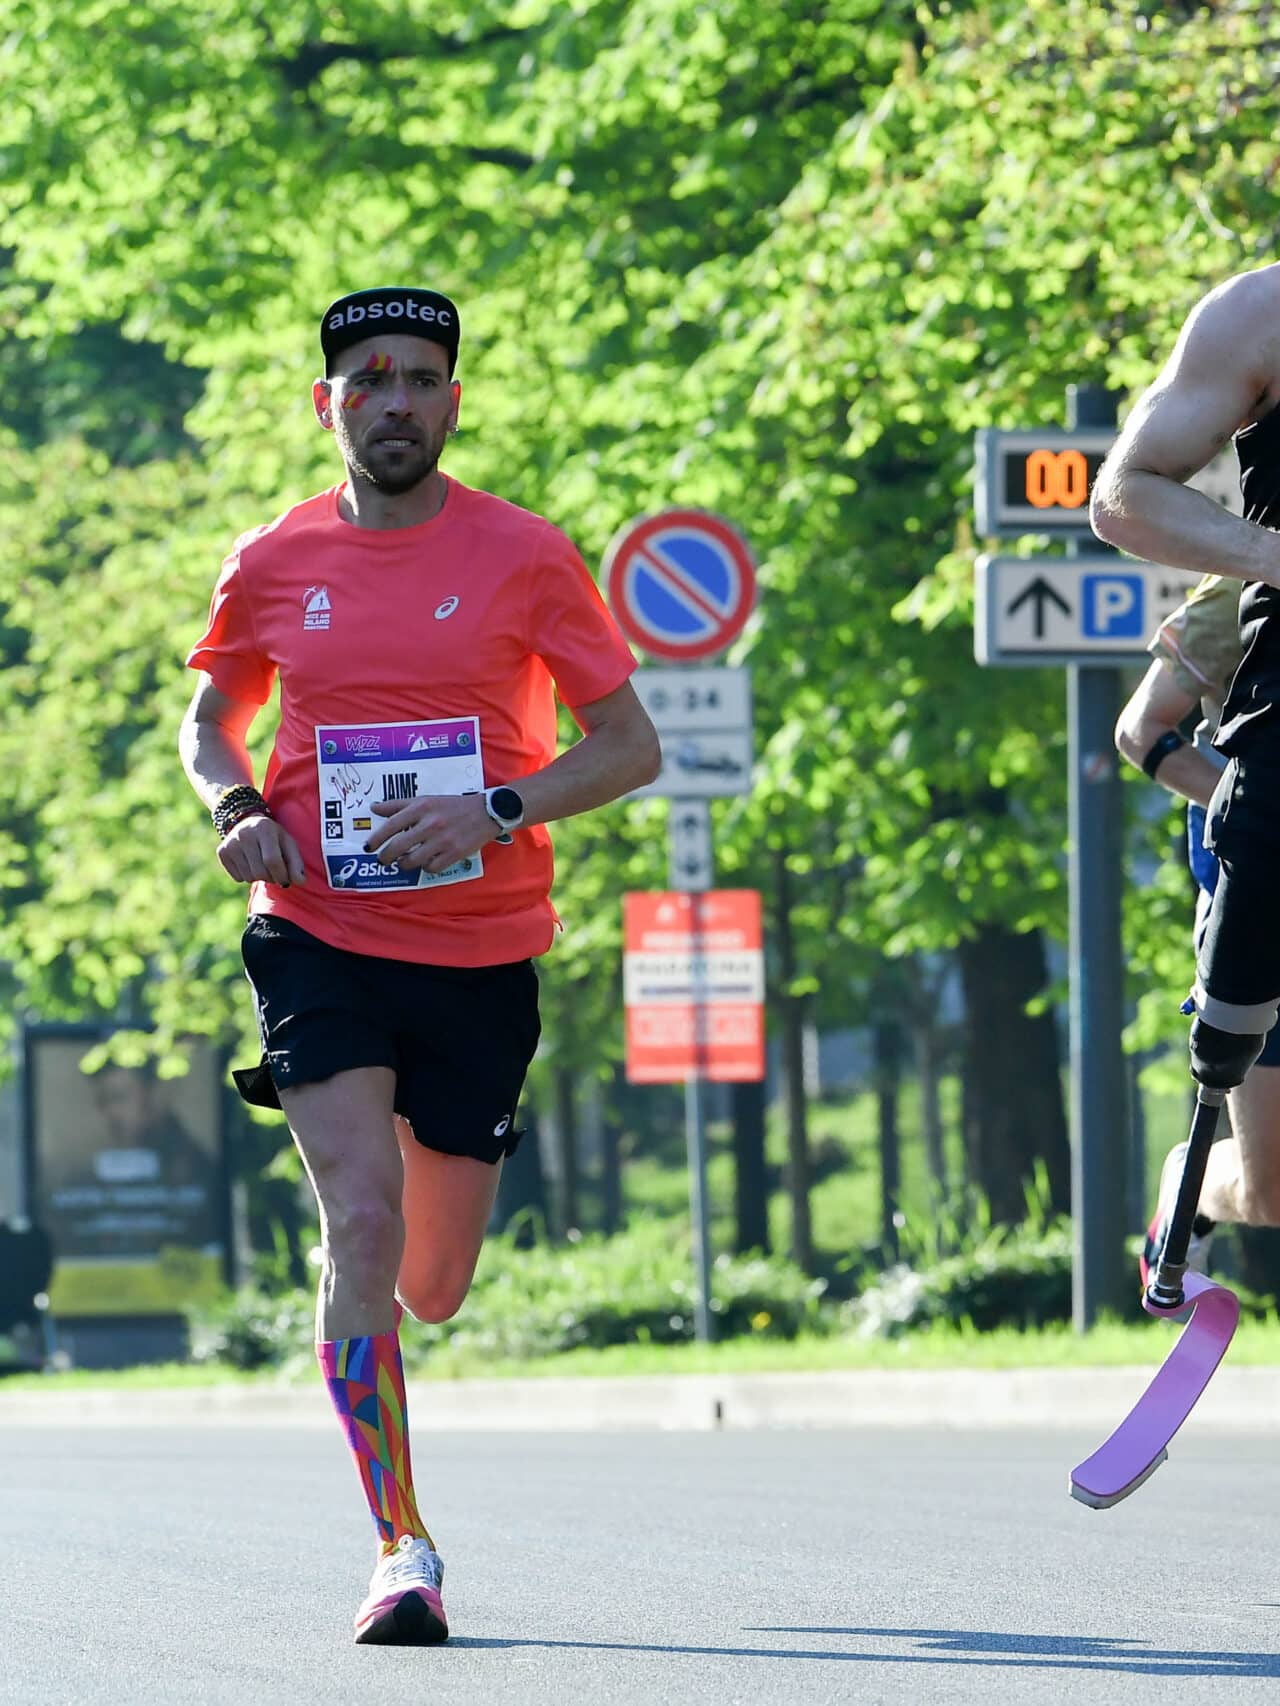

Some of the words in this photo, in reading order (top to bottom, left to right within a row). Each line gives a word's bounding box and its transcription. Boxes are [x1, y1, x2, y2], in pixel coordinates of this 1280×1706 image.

[328, 298, 452, 331] absotec
[1094, 582, 1134, 633] P
[357, 862, 400, 877] asics
